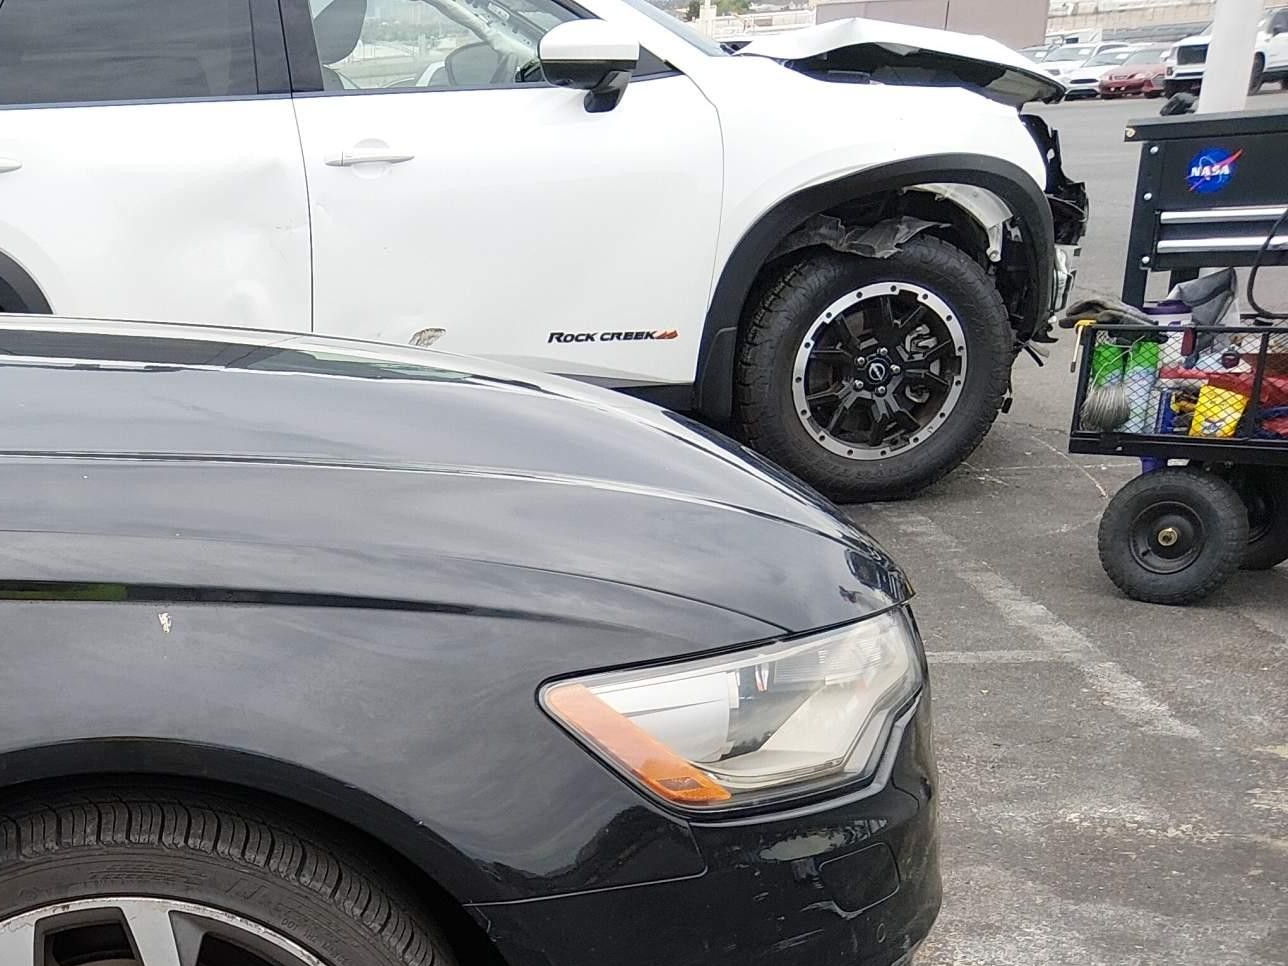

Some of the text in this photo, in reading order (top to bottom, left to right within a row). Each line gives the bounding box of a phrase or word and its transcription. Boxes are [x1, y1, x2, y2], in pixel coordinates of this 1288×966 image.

[1191, 165, 1230, 177] NASA
[548, 331, 657, 343] ROCK CREEK
